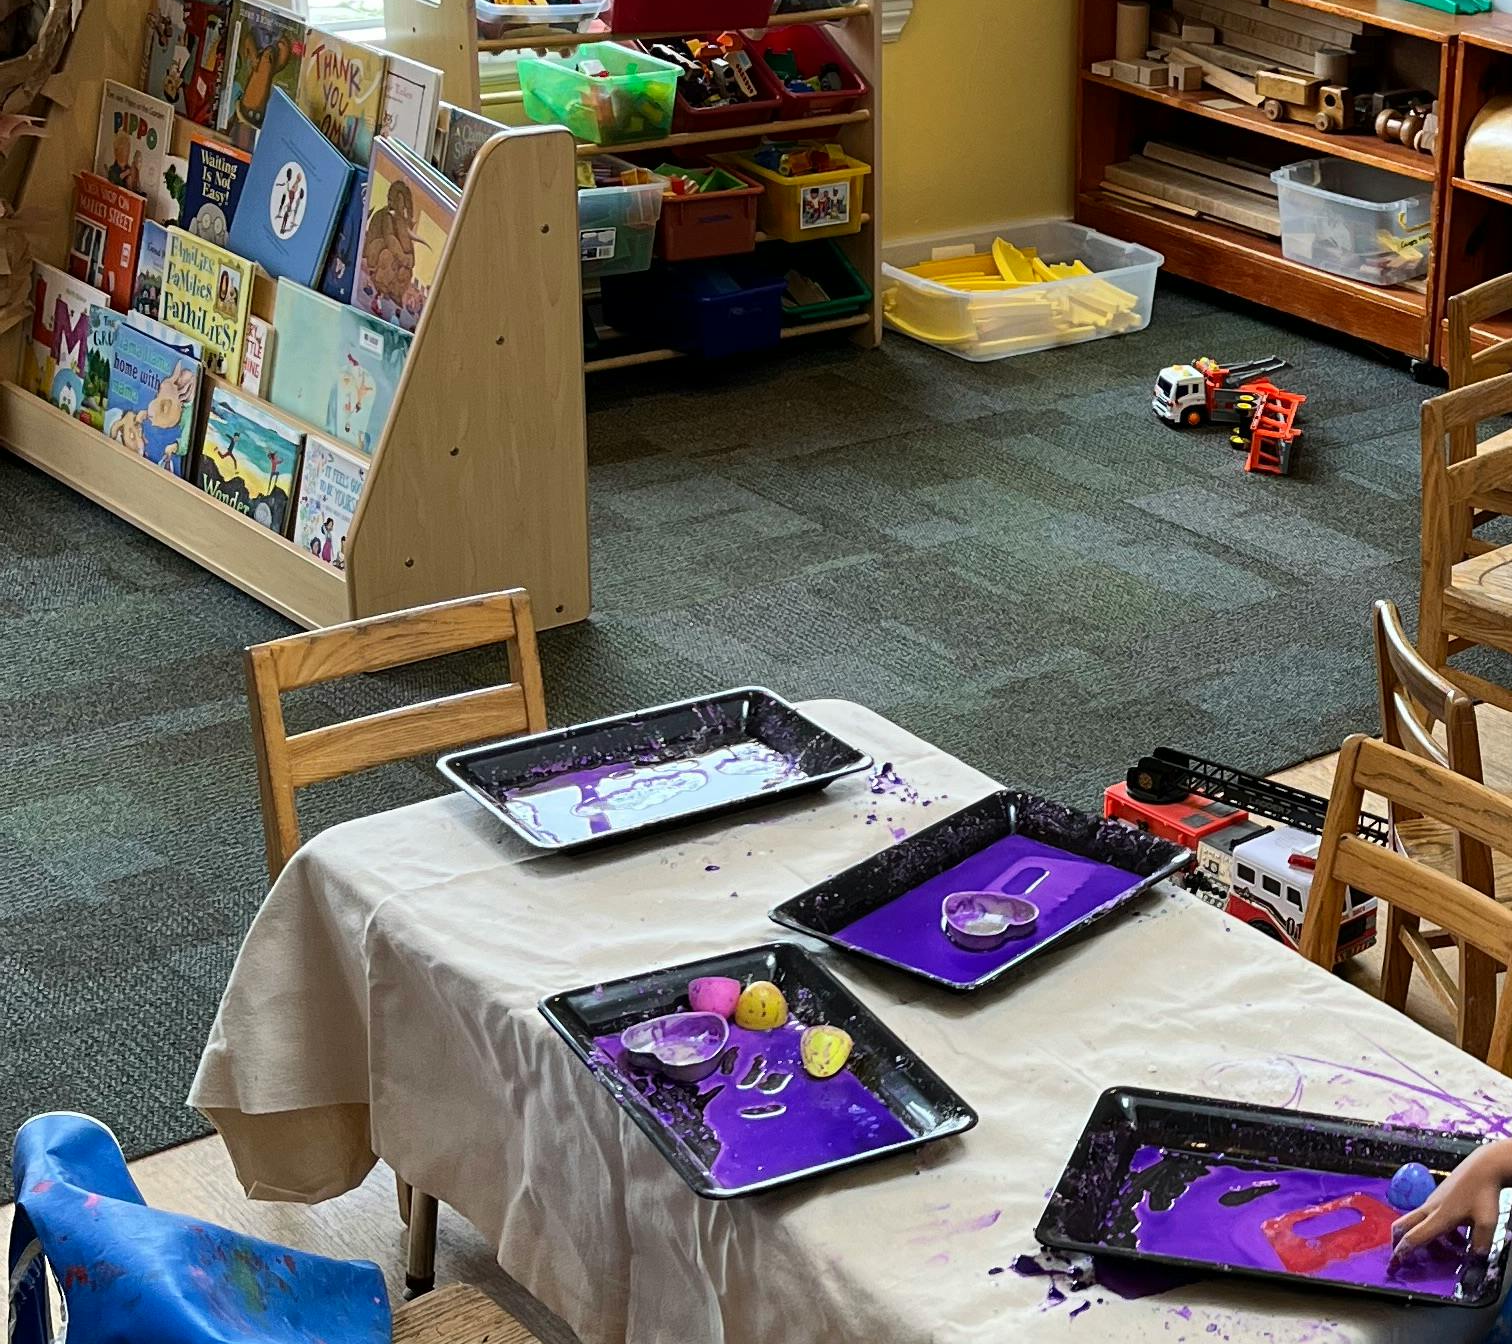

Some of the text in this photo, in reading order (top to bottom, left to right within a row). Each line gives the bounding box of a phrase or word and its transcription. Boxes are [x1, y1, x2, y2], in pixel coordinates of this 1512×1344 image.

[311, 44, 361, 98] THANK
[323, 82, 349, 117] YOU
[113, 111, 158, 151] PIPPO
[201, 149, 238, 180] Waiting
[203, 166, 231, 190] Is Not
[202, 181, 229, 207] Easy!
[108, 207, 134, 233] STREET
[113, 351, 161, 393] home with
[203, 472, 251, 516] Wonder
